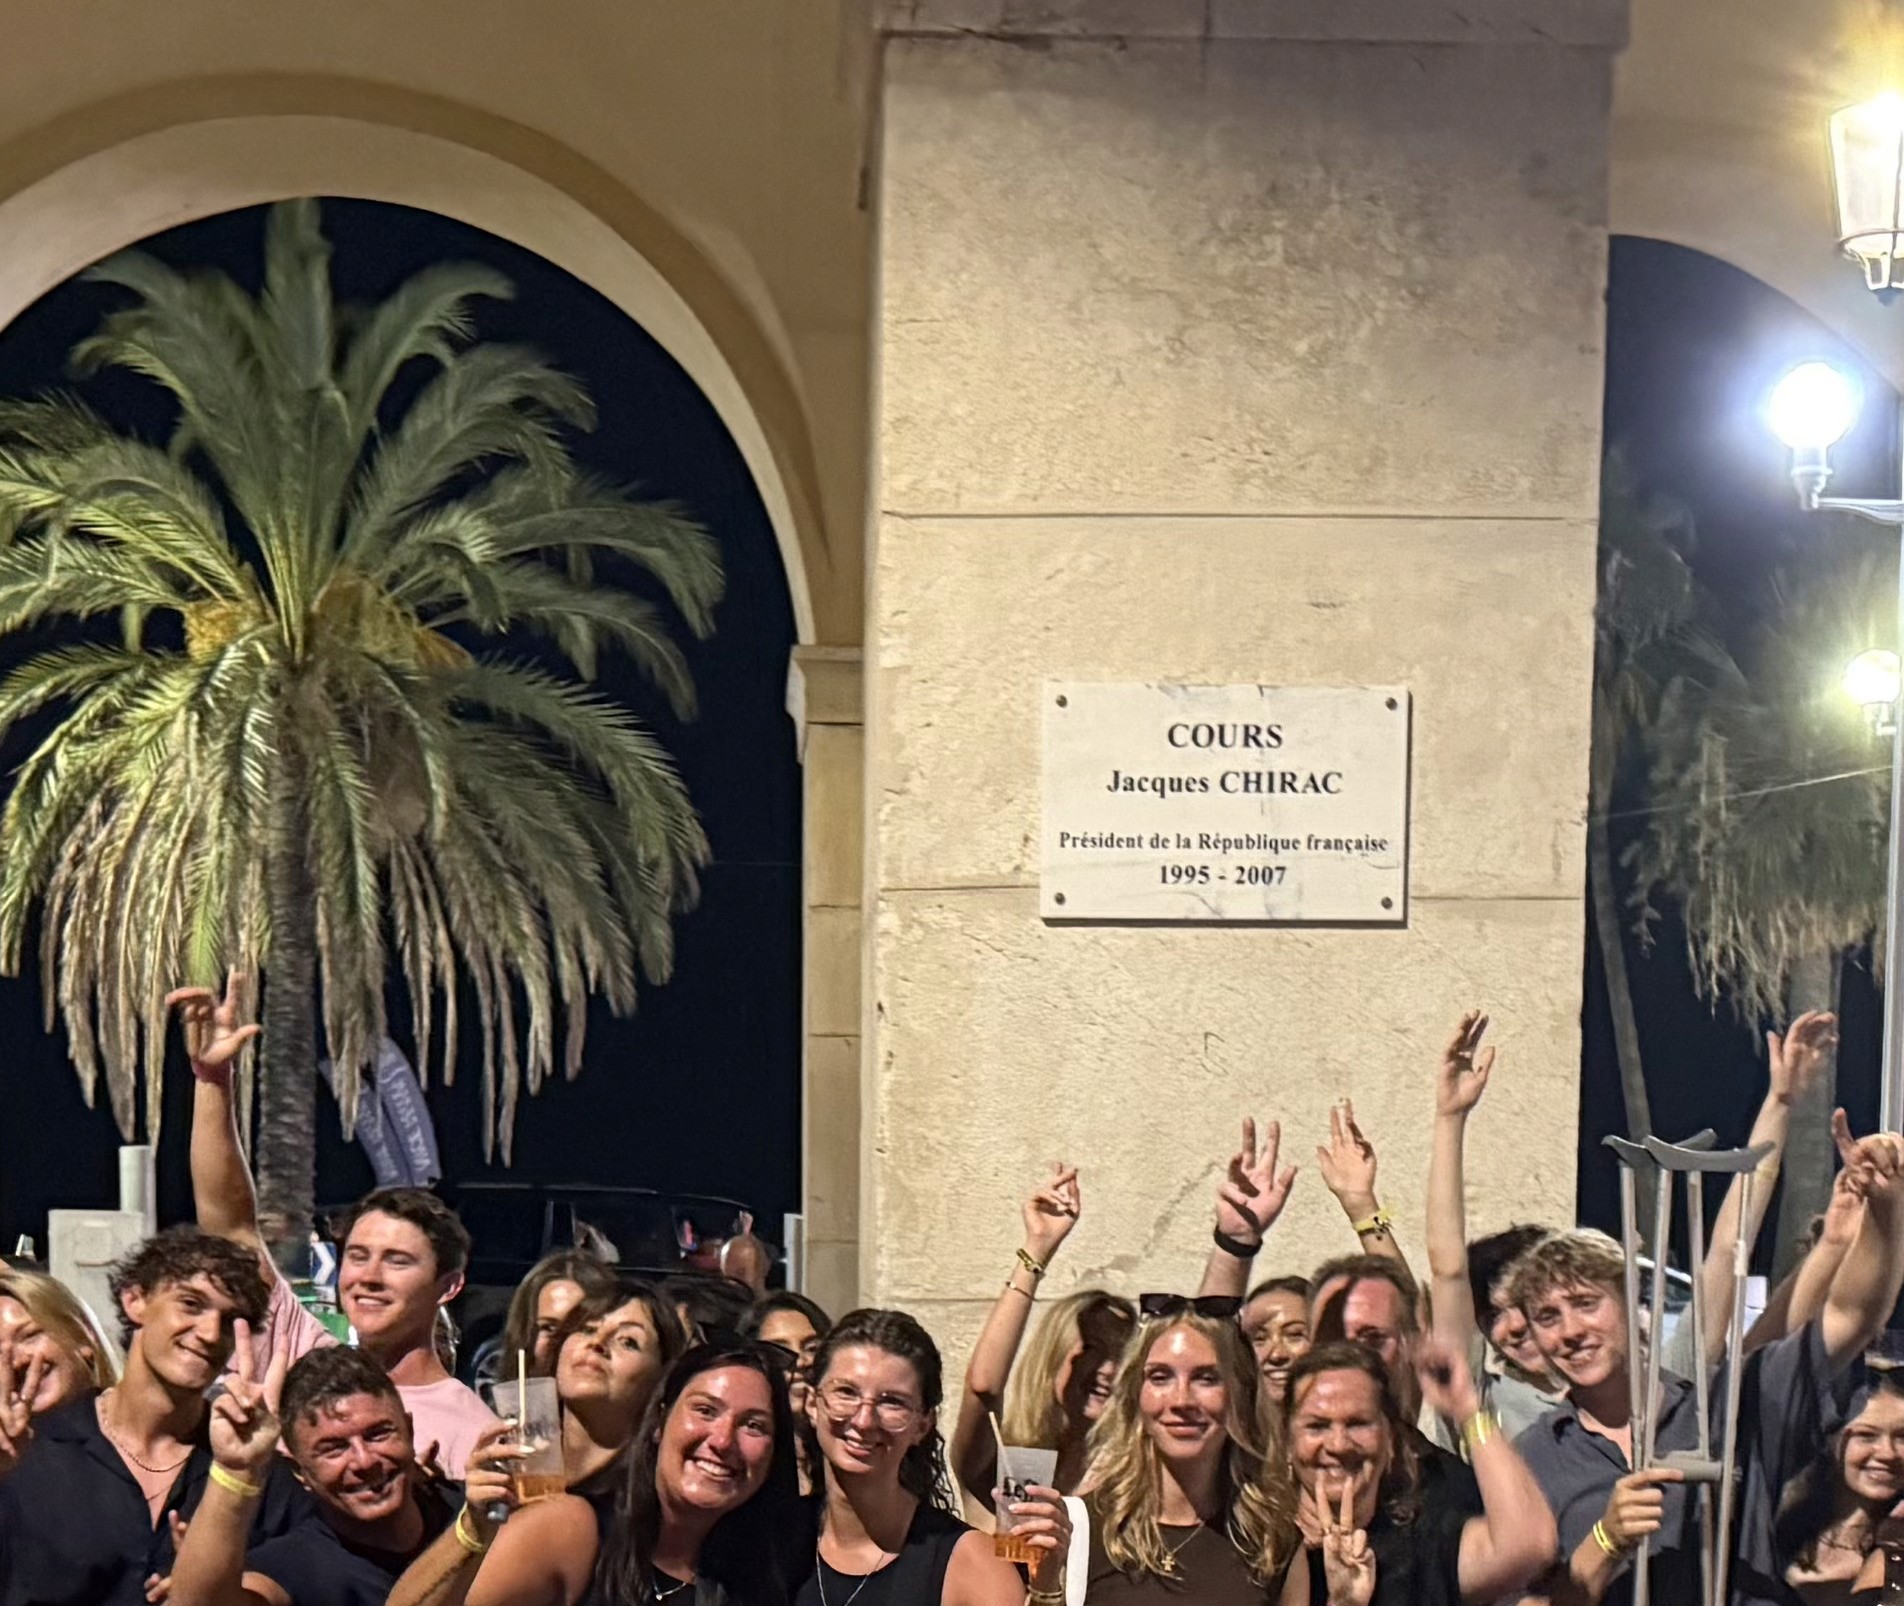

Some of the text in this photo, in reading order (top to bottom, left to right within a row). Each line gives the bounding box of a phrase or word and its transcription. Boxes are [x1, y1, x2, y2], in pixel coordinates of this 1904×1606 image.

[1167, 723, 1283, 749] COURS
[1106, 769, 1343, 798] Jacques CHIRAC
[1059, 831, 1388, 856] Président de la République française
[1160, 864, 1211, 885] 1995
[1234, 865, 1287, 886] 2007
